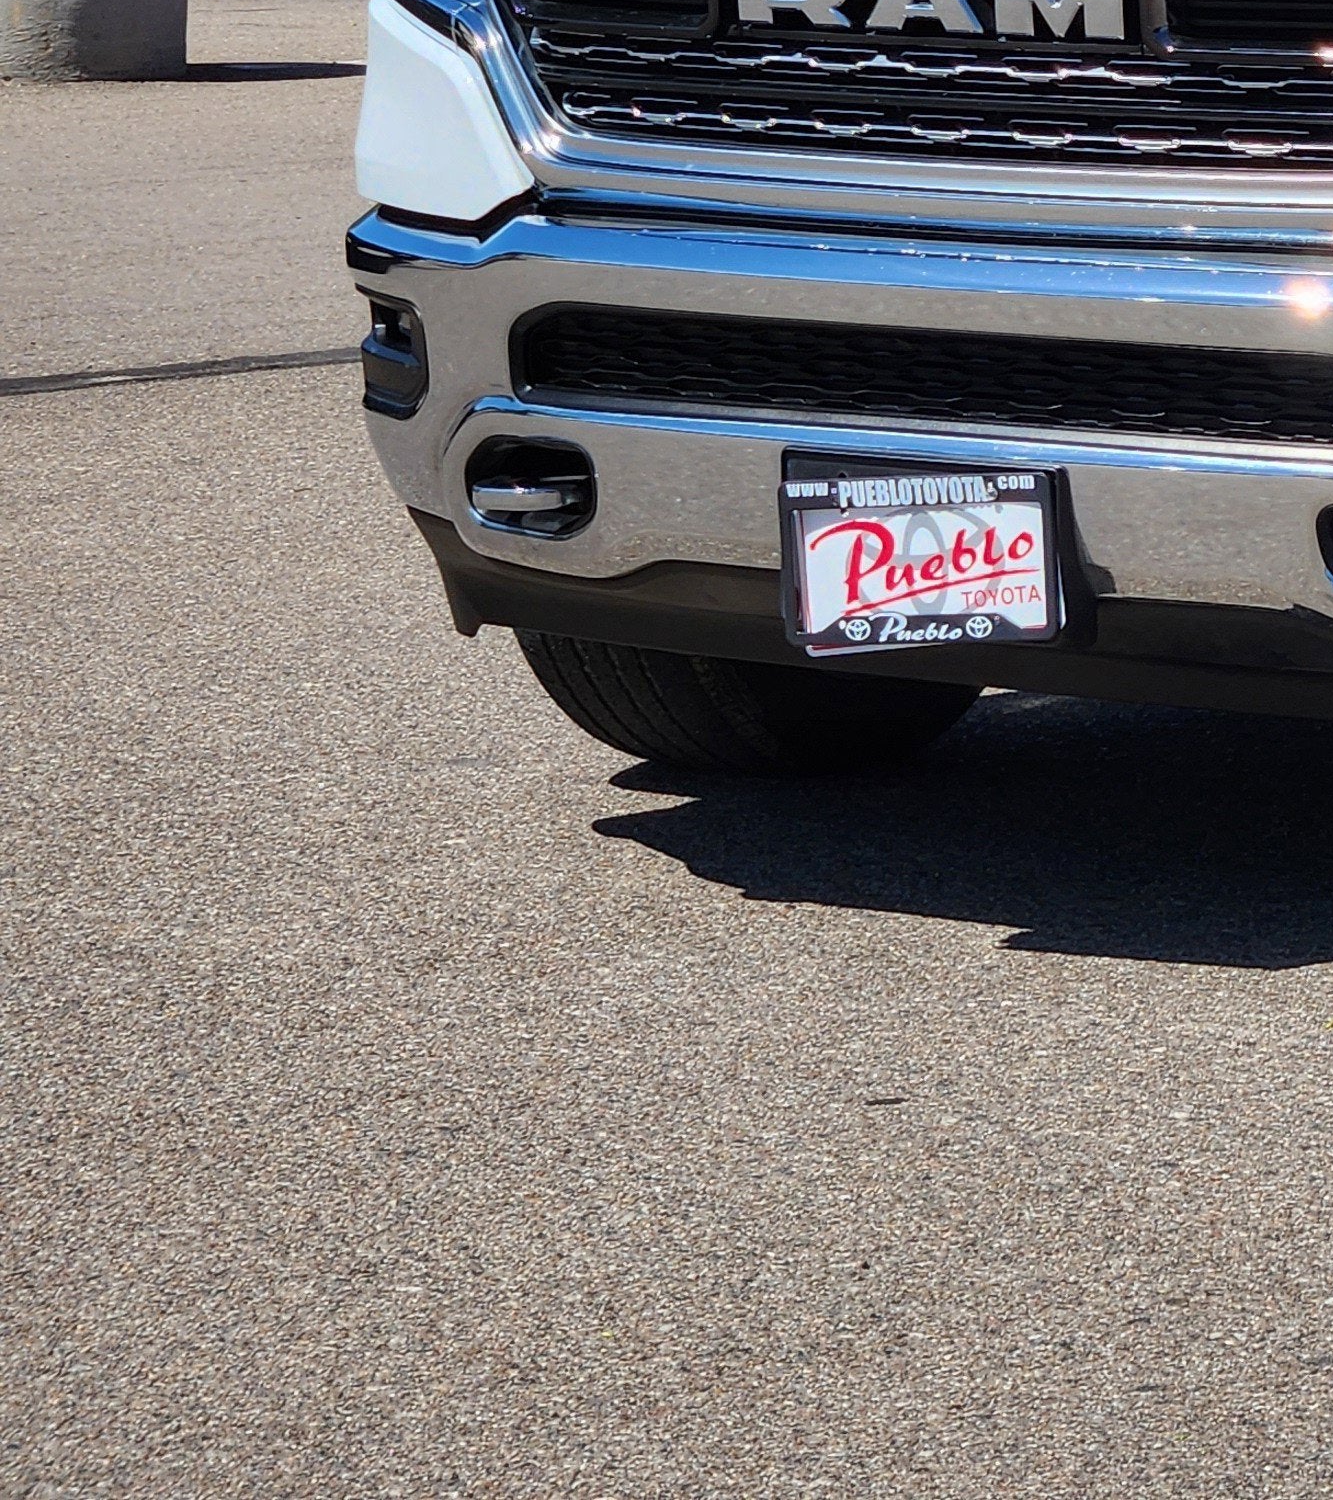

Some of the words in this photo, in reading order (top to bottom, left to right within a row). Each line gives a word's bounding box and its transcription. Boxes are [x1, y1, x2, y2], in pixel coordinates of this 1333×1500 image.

[809, 518, 1034, 605] Pueblo
[961, 584, 1043, 610] TOYOTA
[868, 612, 964, 643] Pueblo
